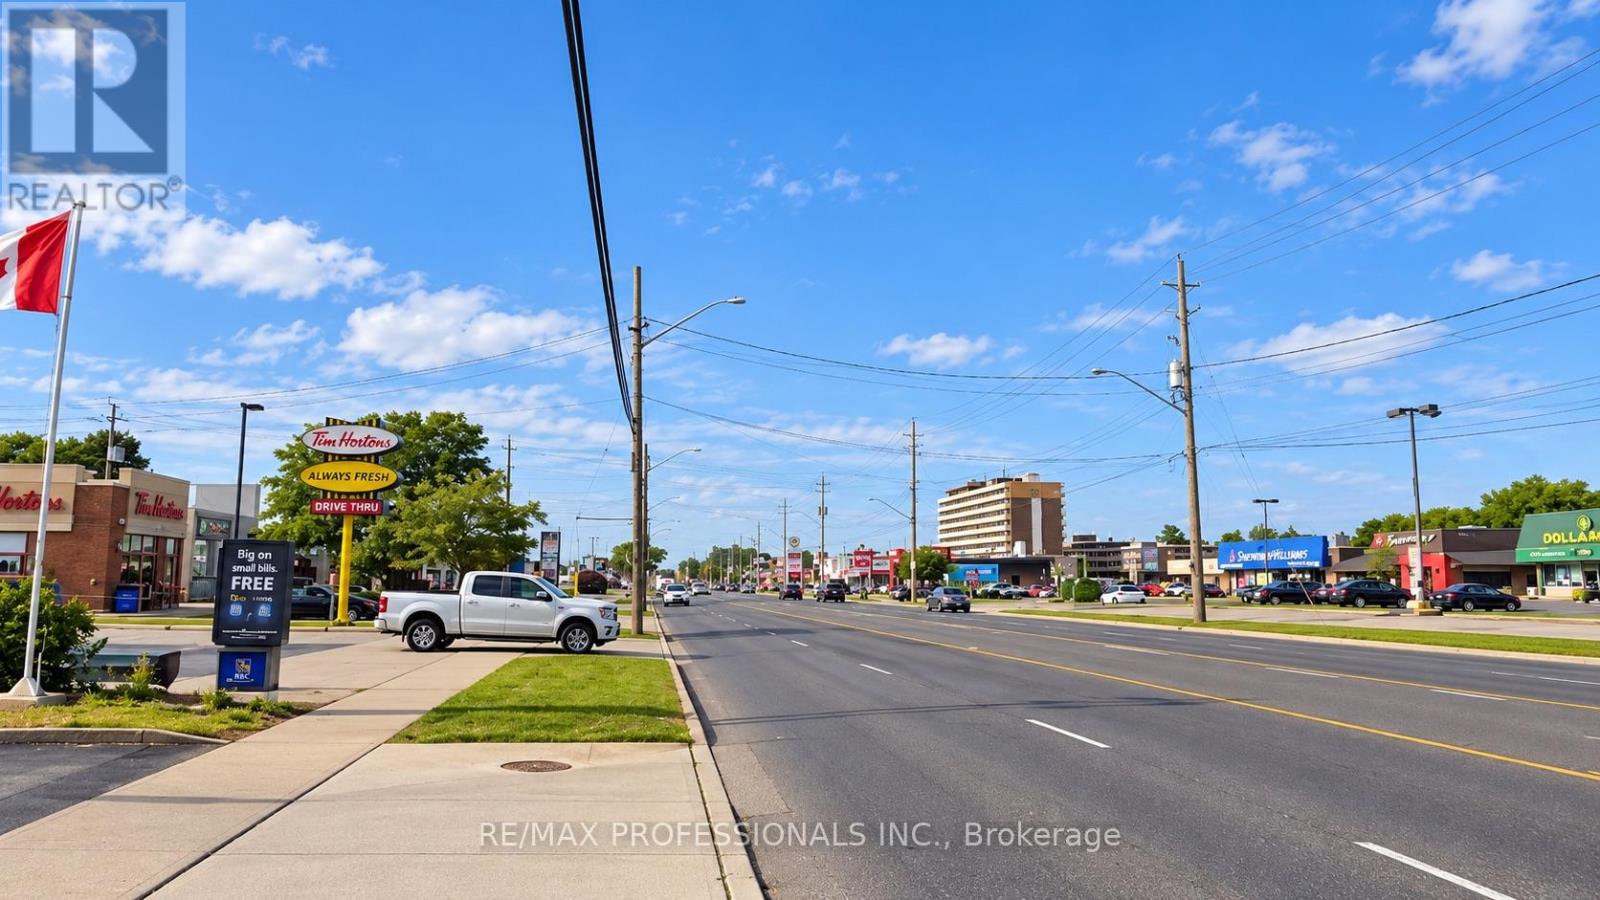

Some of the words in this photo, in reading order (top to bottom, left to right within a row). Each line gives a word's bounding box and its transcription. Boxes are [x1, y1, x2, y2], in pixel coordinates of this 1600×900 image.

[312, 431, 336, 447] Tim
[338, 431, 391, 448] Hortons
[308, 472, 351, 481] ALWAYS
[354, 472, 390, 482] FRESH
[315, 502, 347, 512] DRIVE
[350, 502, 379, 512] THRU
[238, 549, 255, 562] Big
[258, 552, 272, 560] on
[231, 563, 256, 573] small
[258, 564, 278, 573] bills.
[231, 576, 274, 591] FREE
